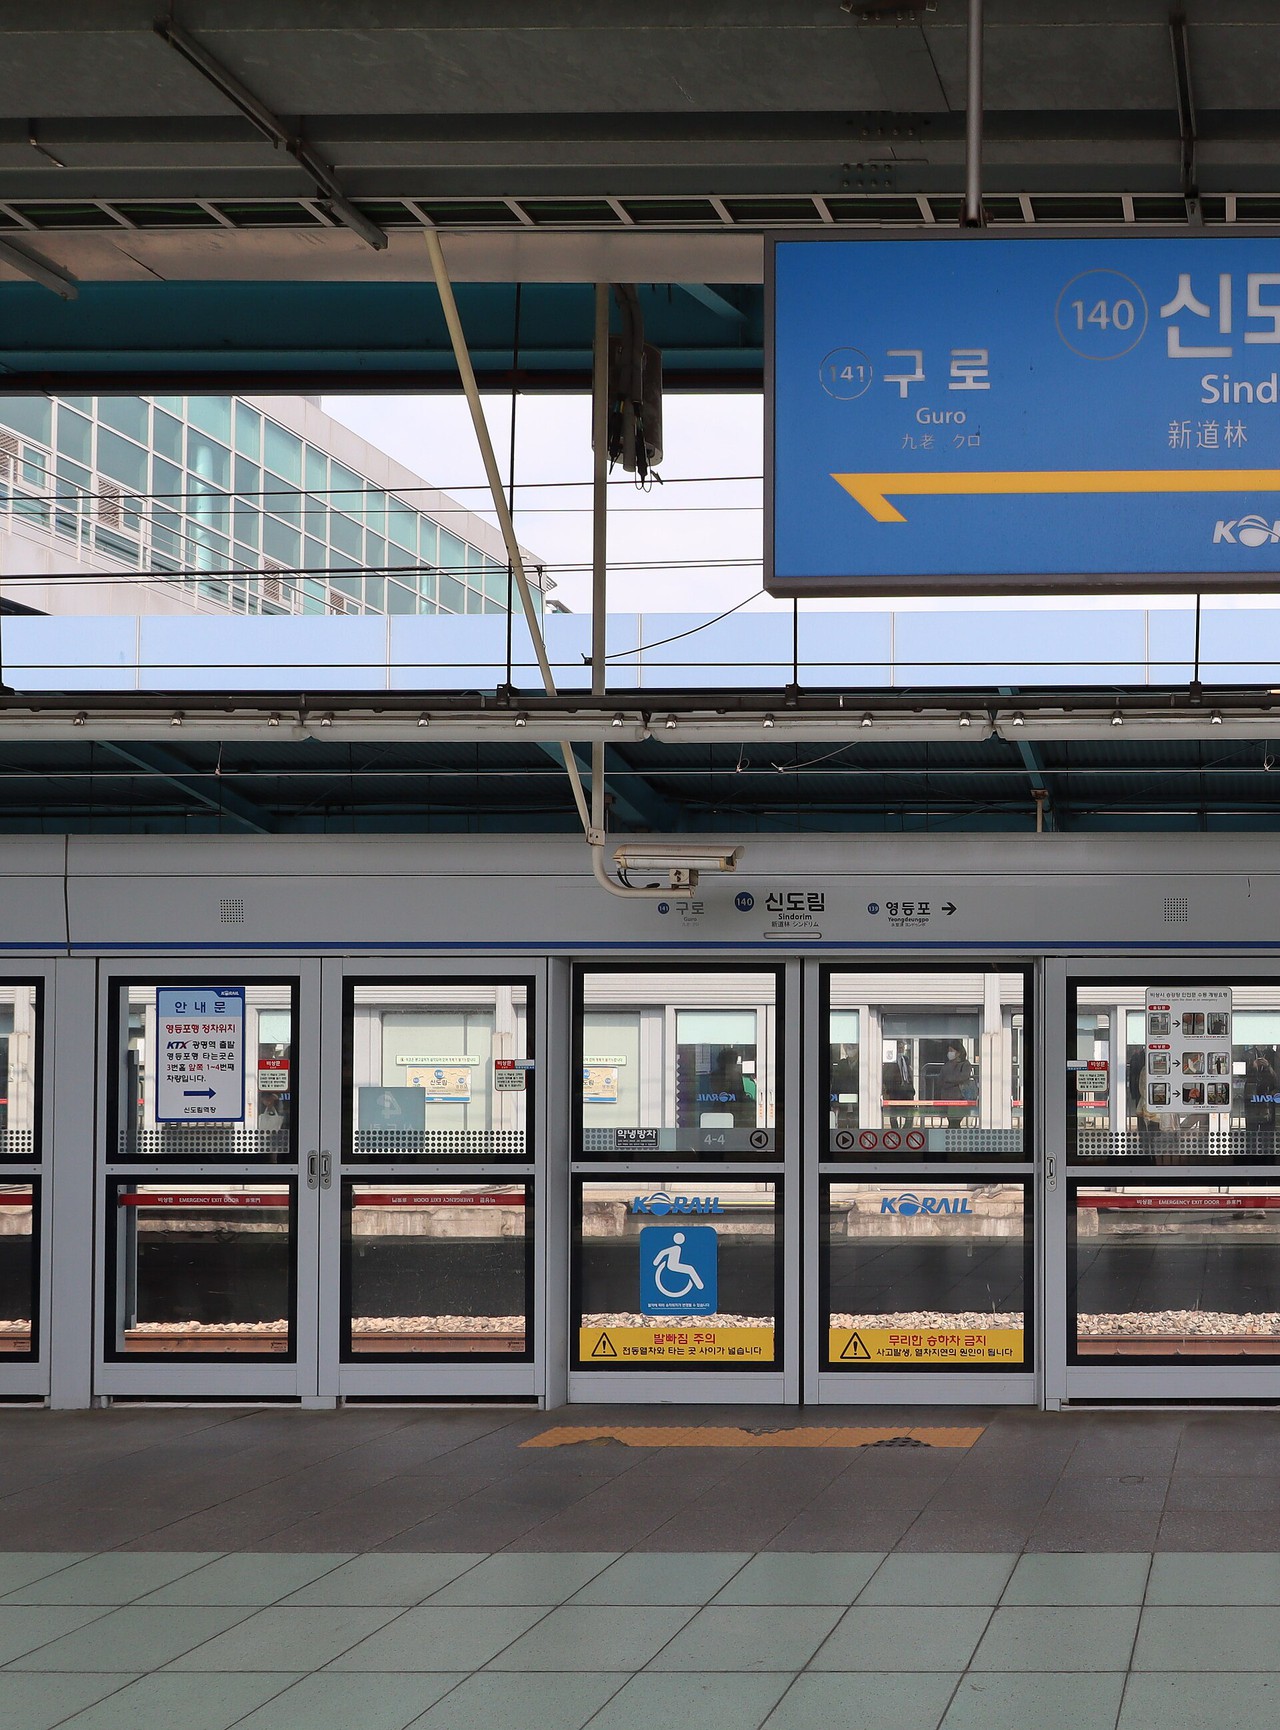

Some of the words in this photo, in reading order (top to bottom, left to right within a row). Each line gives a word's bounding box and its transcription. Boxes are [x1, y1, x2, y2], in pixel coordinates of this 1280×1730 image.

[1071, 300, 1134, 330] 140
[829, 365, 866, 383] 141
[916, 408, 966, 425] Guro
[1168, 420, 1248, 449] 新道林
[901, 433, 935, 450] 九老
[952, 434, 980, 448] クロ
[737, 897, 753, 907] 140
[765, 892, 825, 912] 신도림
[676, 902, 705, 915] 구로
[886, 902, 931, 916] 영등포
[166, 1024, 200, 1034] 영등포행
[202, 1024, 236, 1034] 정차위치
[167, 1040, 193, 1049] KTX
[220, 1041, 235, 1049] 출발
[167, 1053, 199, 1061] 영등포행
[167, 1064, 186, 1072] 3번홈
[189, 1064, 204, 1072] 앞쪽
[167, 1075, 206, 1083] 차량입니다.
[617, 1129, 656, 1139] 약냉방차
[704, 1136, 726, 1145] 4-4
[632, 1192, 725, 1216] KORAIL
[880, 1193, 973, 1216] KORAIL
[654, 1333, 688, 1344] 발빠짐
[693, 1333, 716, 1344] 주의
[889, 1335, 923, 1346] 무리한
[927, 1335, 960, 1346] 승하차
[964, 1335, 987, 1346] 금지
[623, 1346, 665, 1355] 전동열차와
[668, 1346, 685, 1355] 타는
[689, 1346, 696, 1355] 곳
[699, 1346, 725, 1355] 사이가
[728, 1346, 762, 1355] 넓습니다
[876, 1348, 912, 1357] 사고발생,
[915, 1348, 957, 1357] 열차지연의
[960, 1348, 984, 1357] 원인이
[988, 1348, 1013, 1357] 됩니다
